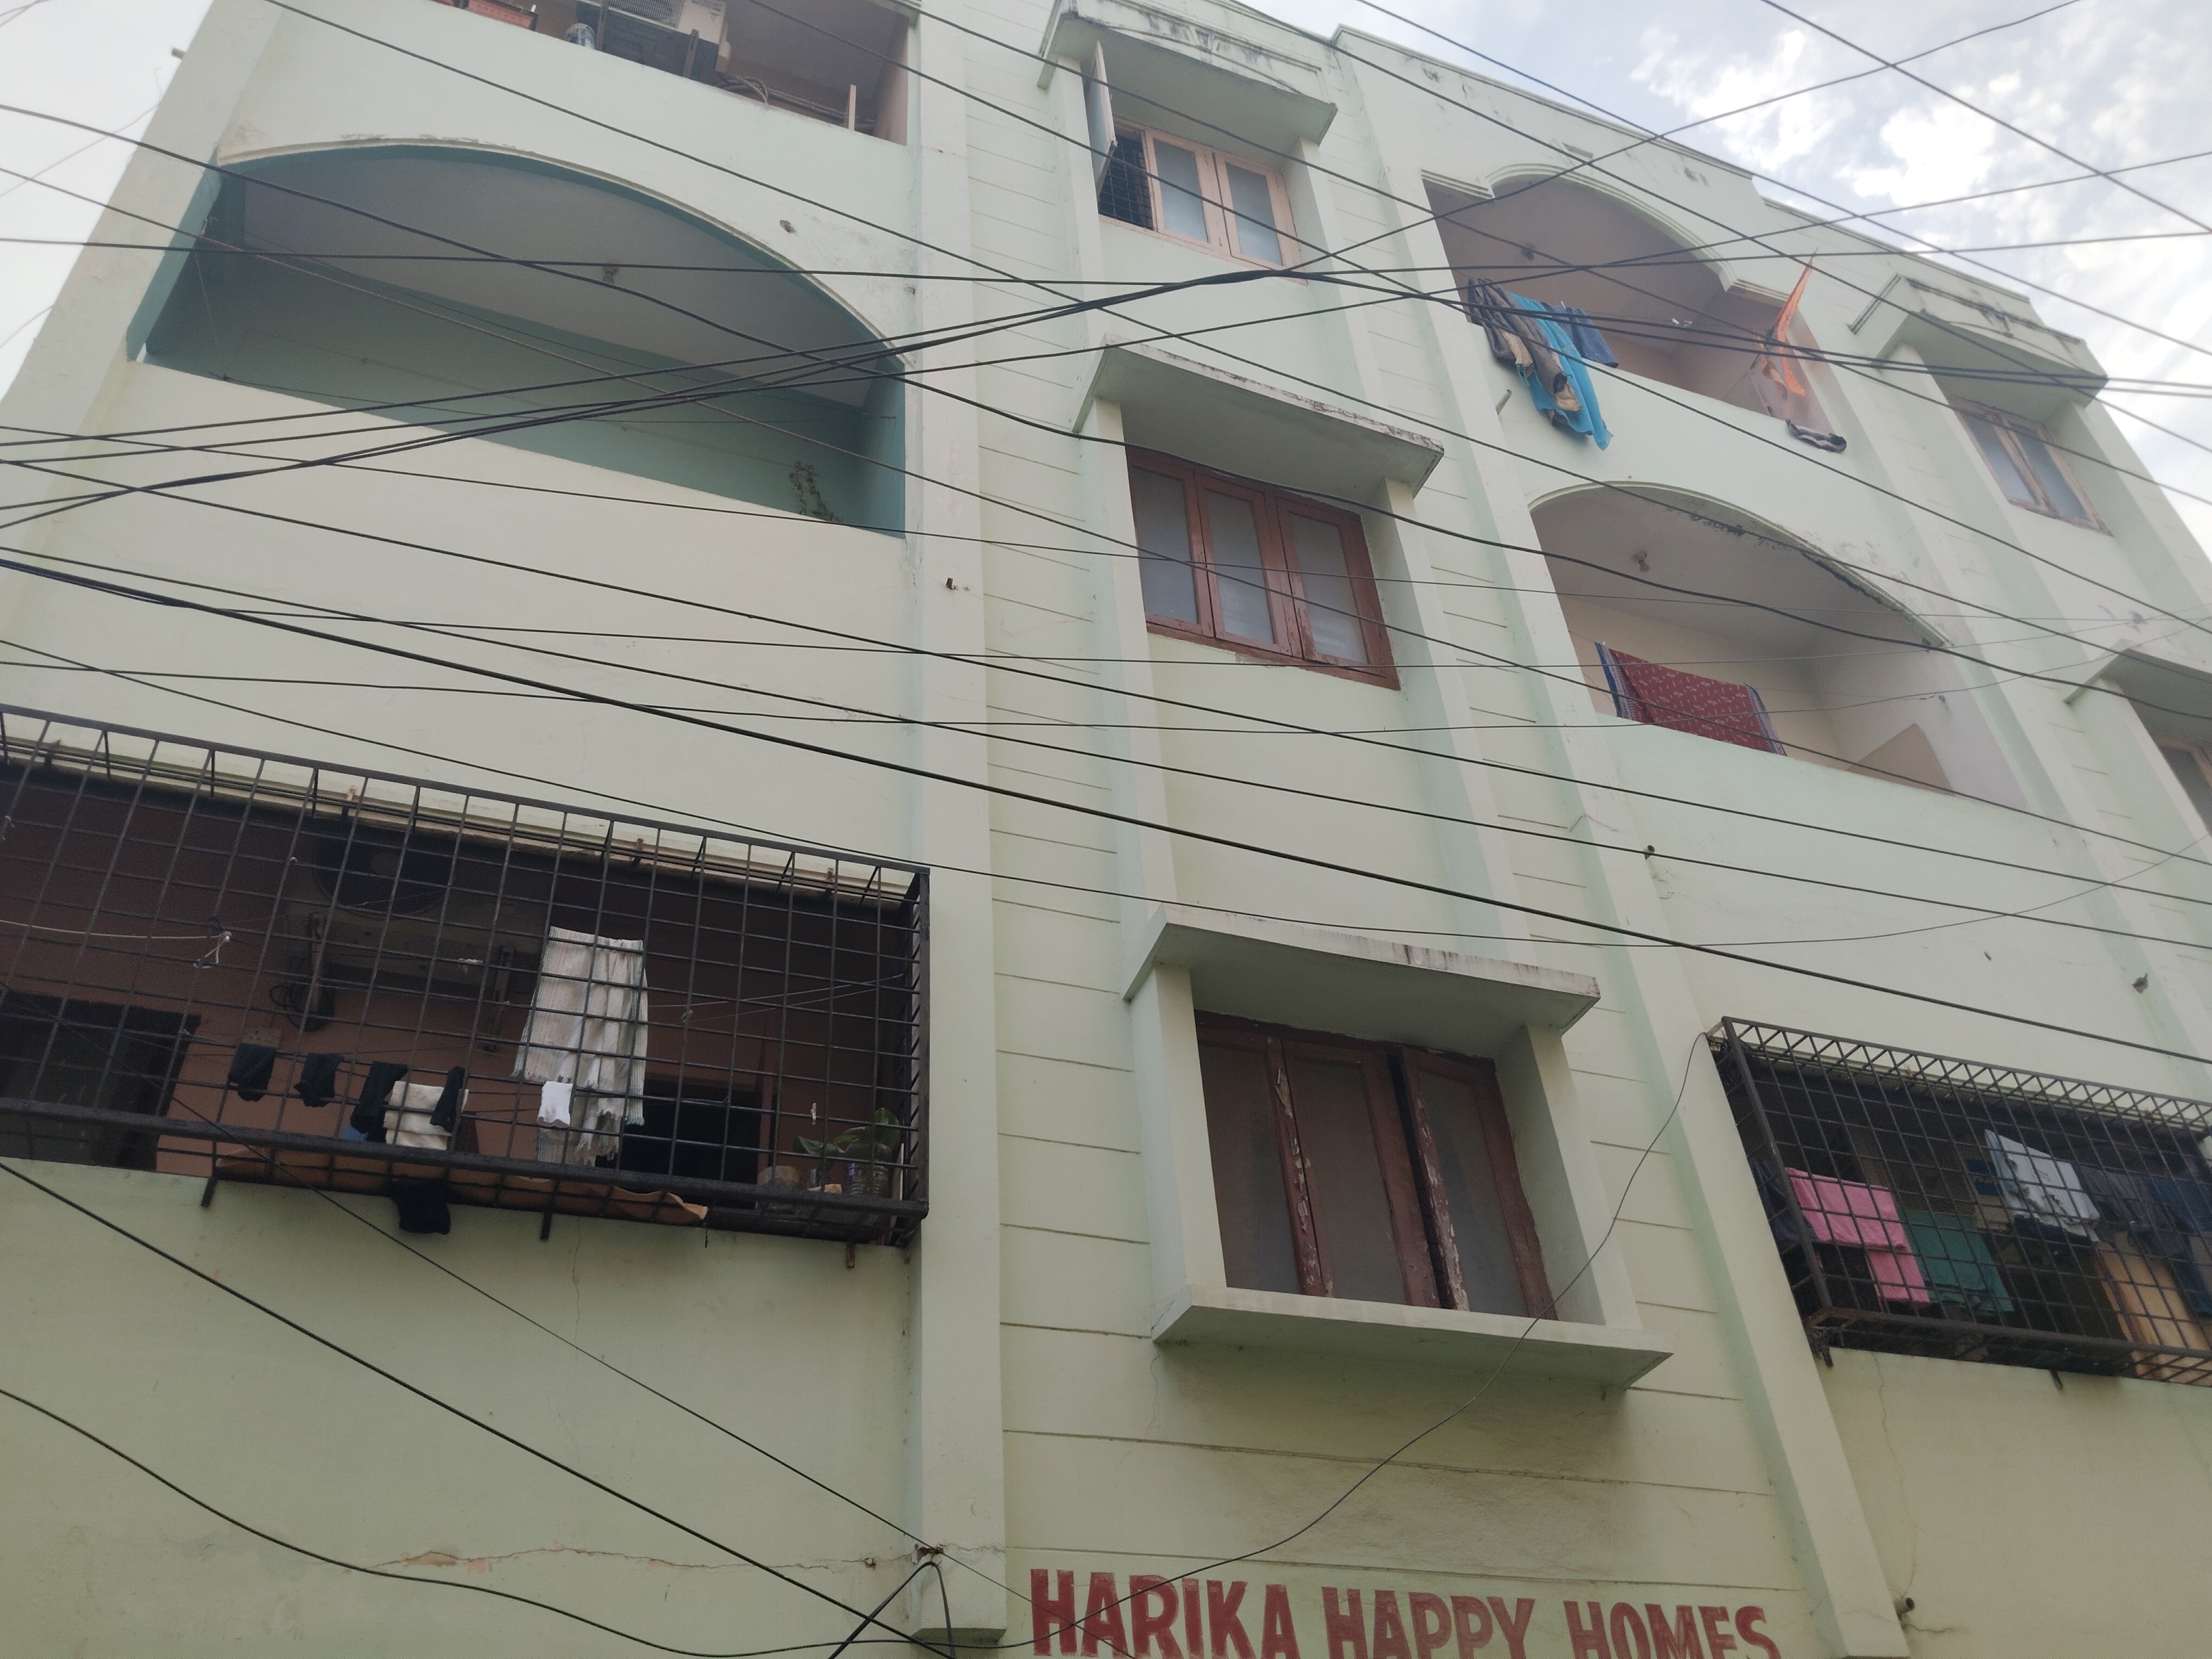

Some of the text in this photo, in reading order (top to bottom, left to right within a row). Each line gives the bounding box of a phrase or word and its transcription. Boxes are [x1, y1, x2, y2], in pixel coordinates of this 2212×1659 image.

[1030, 1568, 1782, 1659] HARIKA HAPPY HOMES
